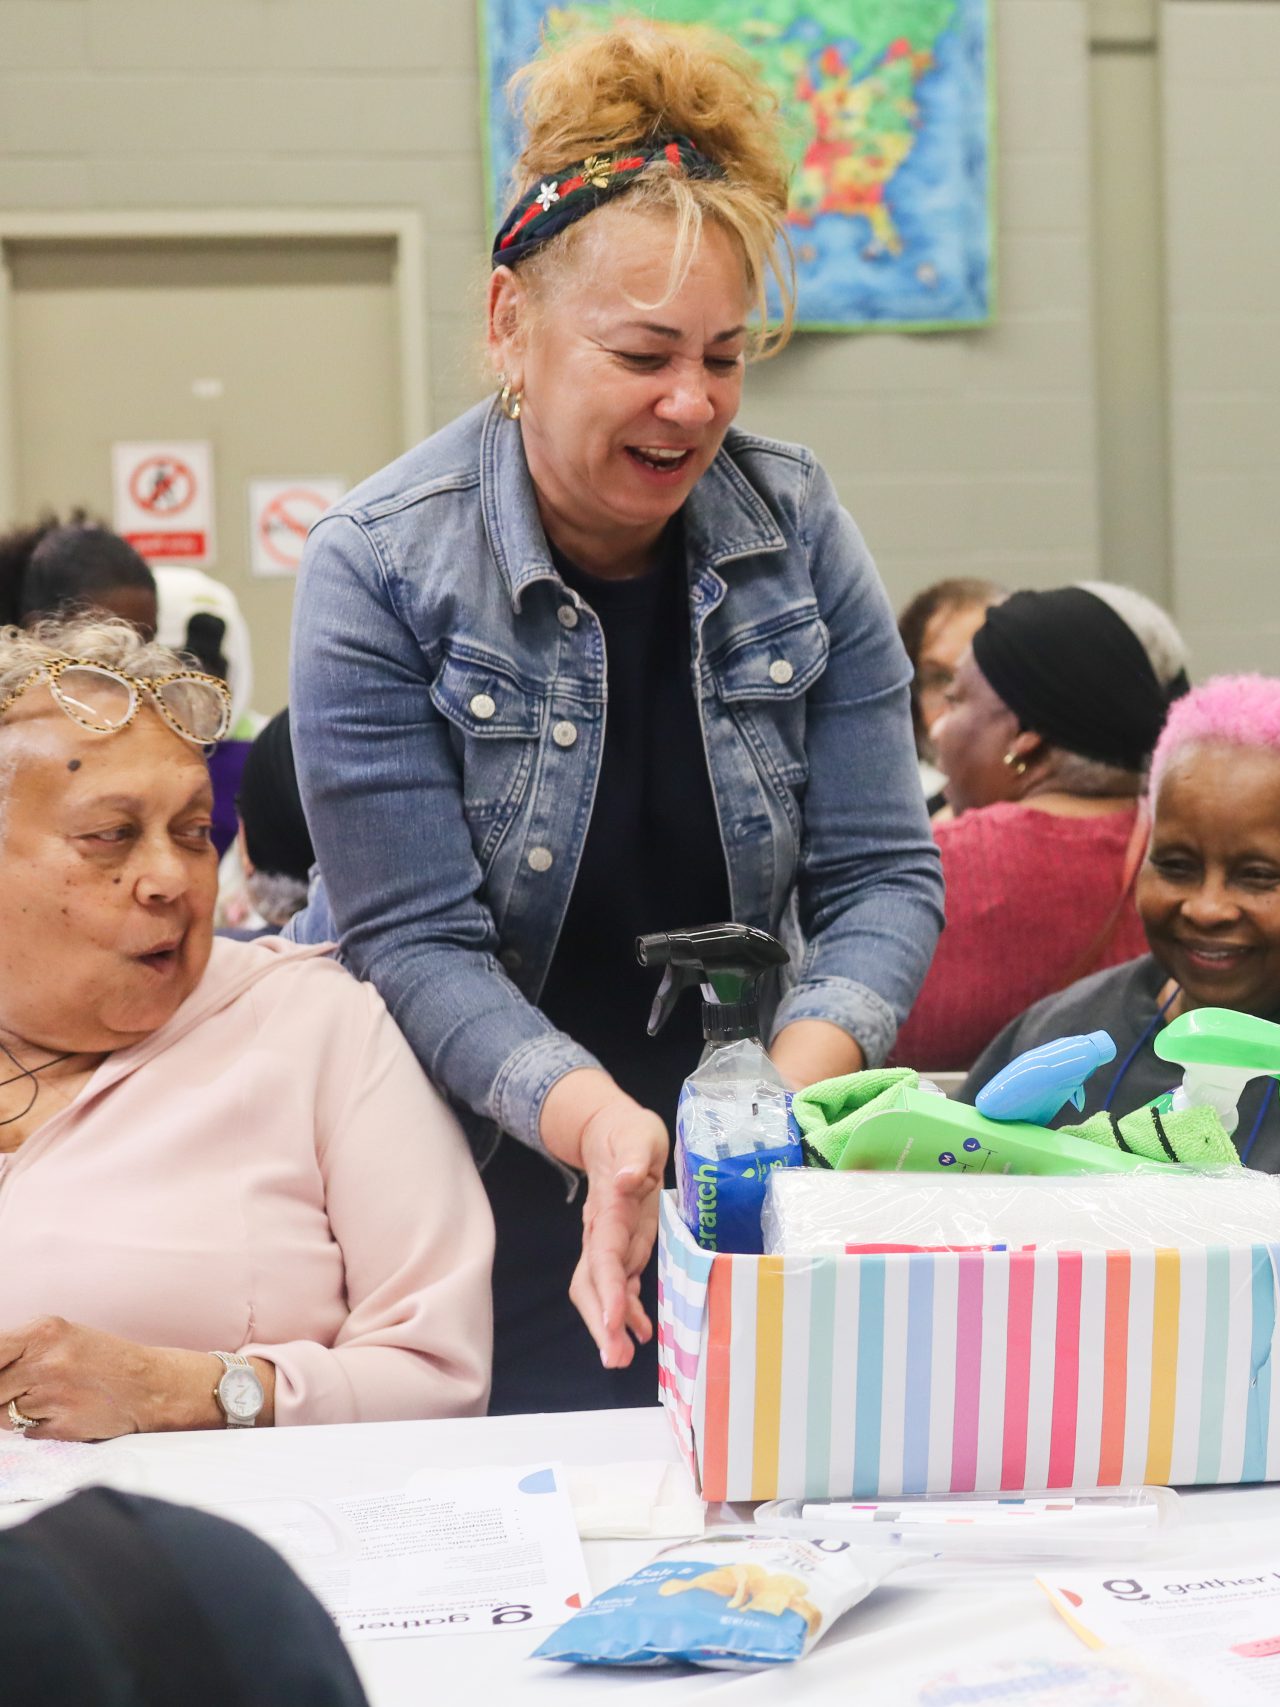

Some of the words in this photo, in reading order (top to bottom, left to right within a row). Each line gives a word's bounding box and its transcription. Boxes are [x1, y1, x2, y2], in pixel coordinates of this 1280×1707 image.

[692, 1163, 719, 1252] cratch
[1163, 1574, 1267, 1595] gather
[354, 1614, 471, 1631] gather
